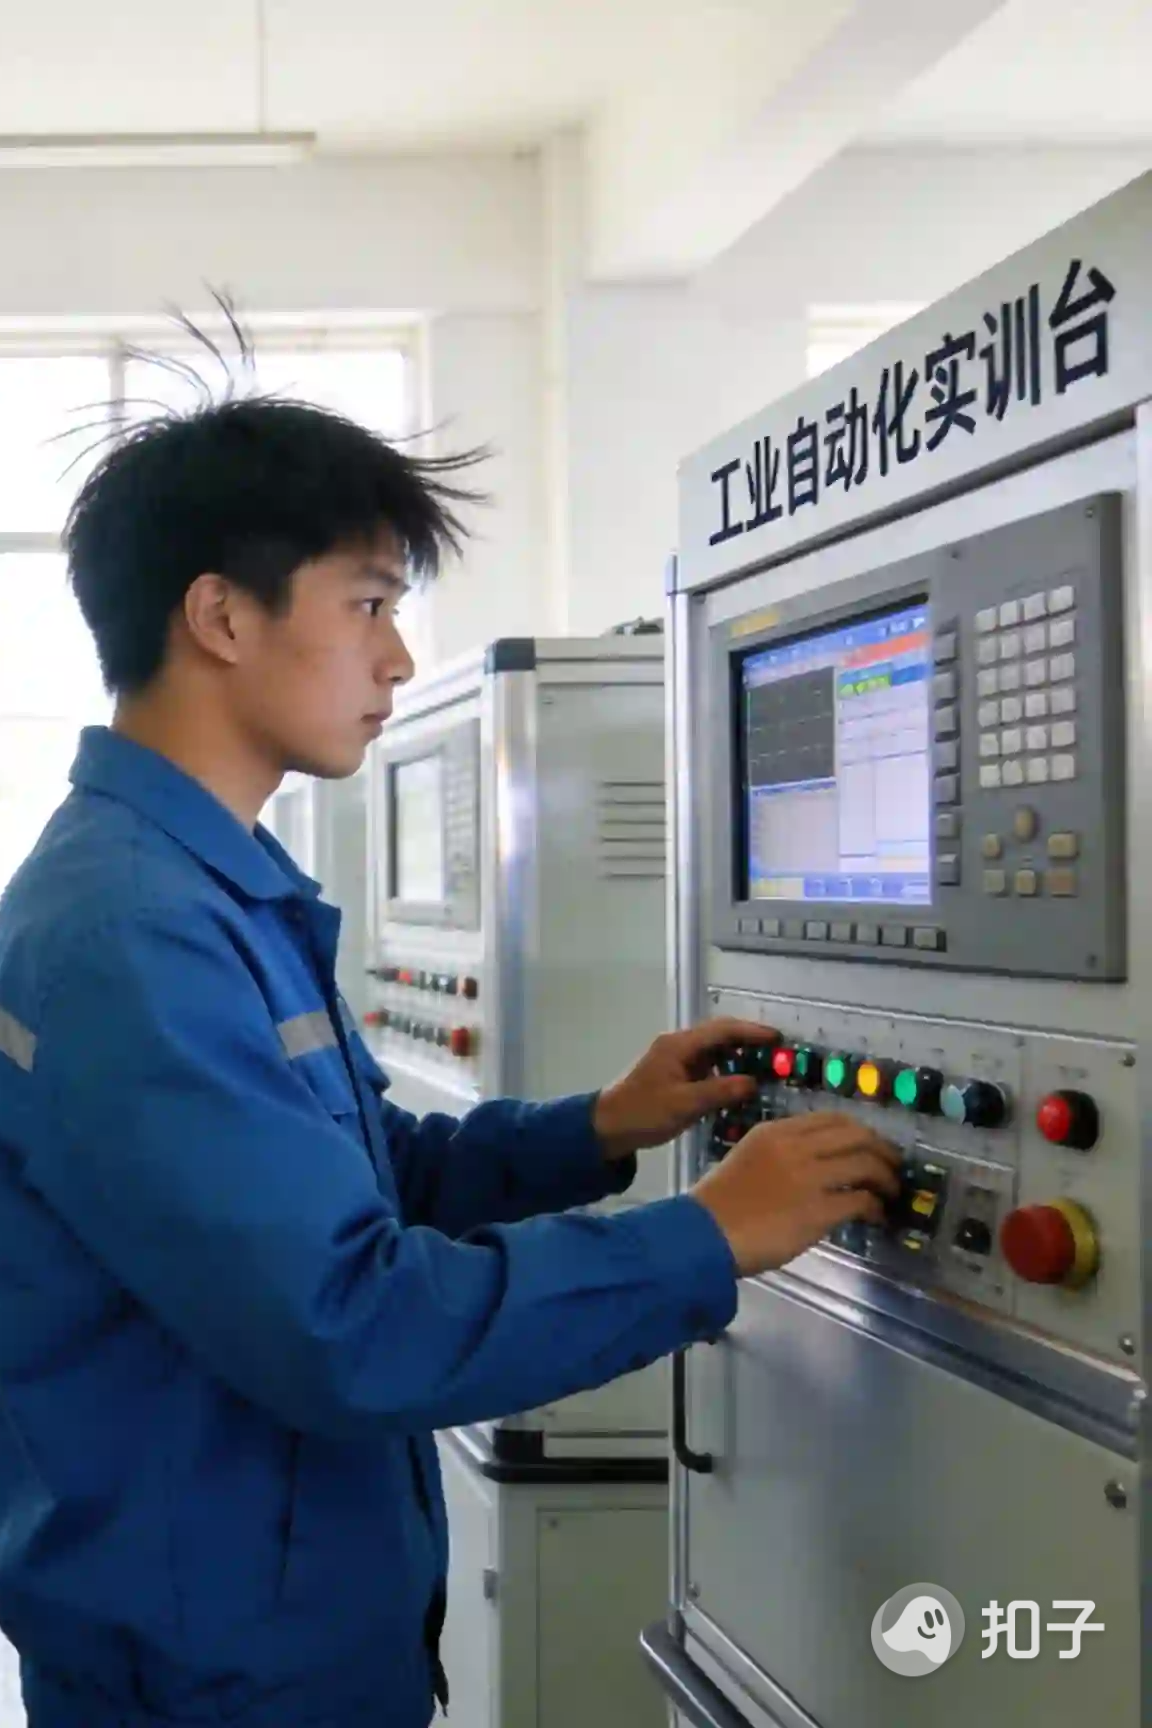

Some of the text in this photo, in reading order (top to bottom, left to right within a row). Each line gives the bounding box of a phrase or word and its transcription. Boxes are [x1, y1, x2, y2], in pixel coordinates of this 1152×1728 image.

[709, 259, 1116, 546] 工业自动化实训台
